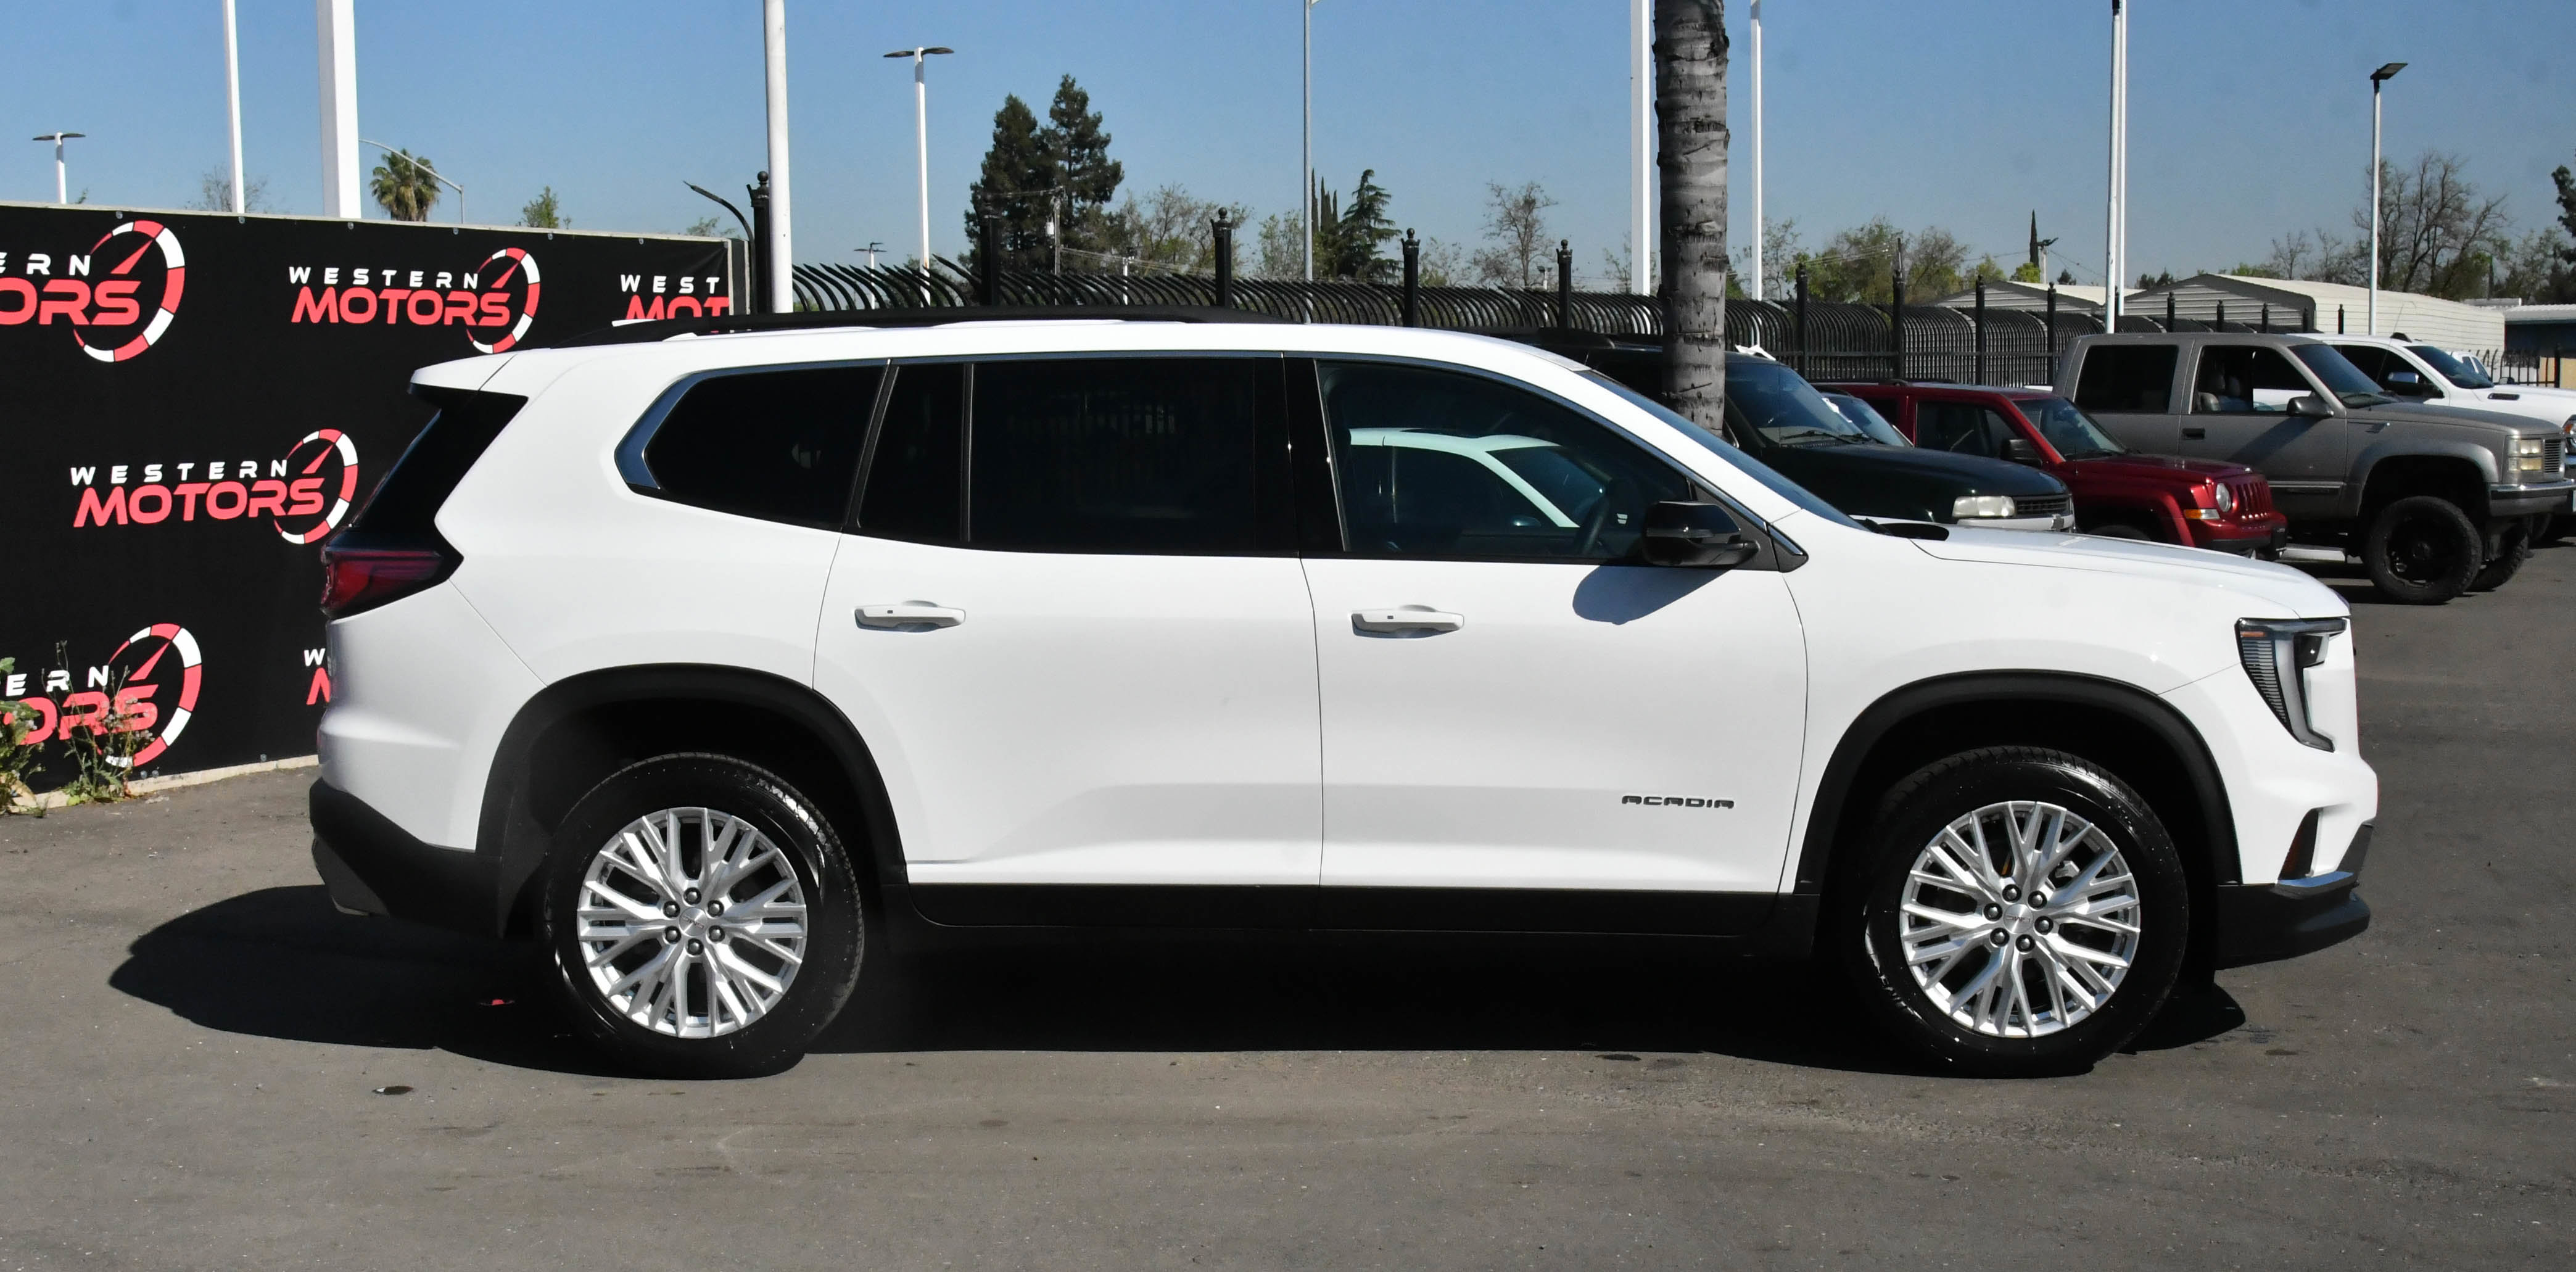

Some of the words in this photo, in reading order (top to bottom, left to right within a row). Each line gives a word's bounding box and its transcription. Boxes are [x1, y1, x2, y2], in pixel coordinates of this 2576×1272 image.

[289, 266, 479, 289] WESTERN
[621, 275, 719, 294] WEST
[291, 286, 511, 326] MOTORS
[70, 459, 287, 486] WESTERN
[73, 477, 325, 528] MOTORS
[1621, 795, 1735, 809] ACADIA
